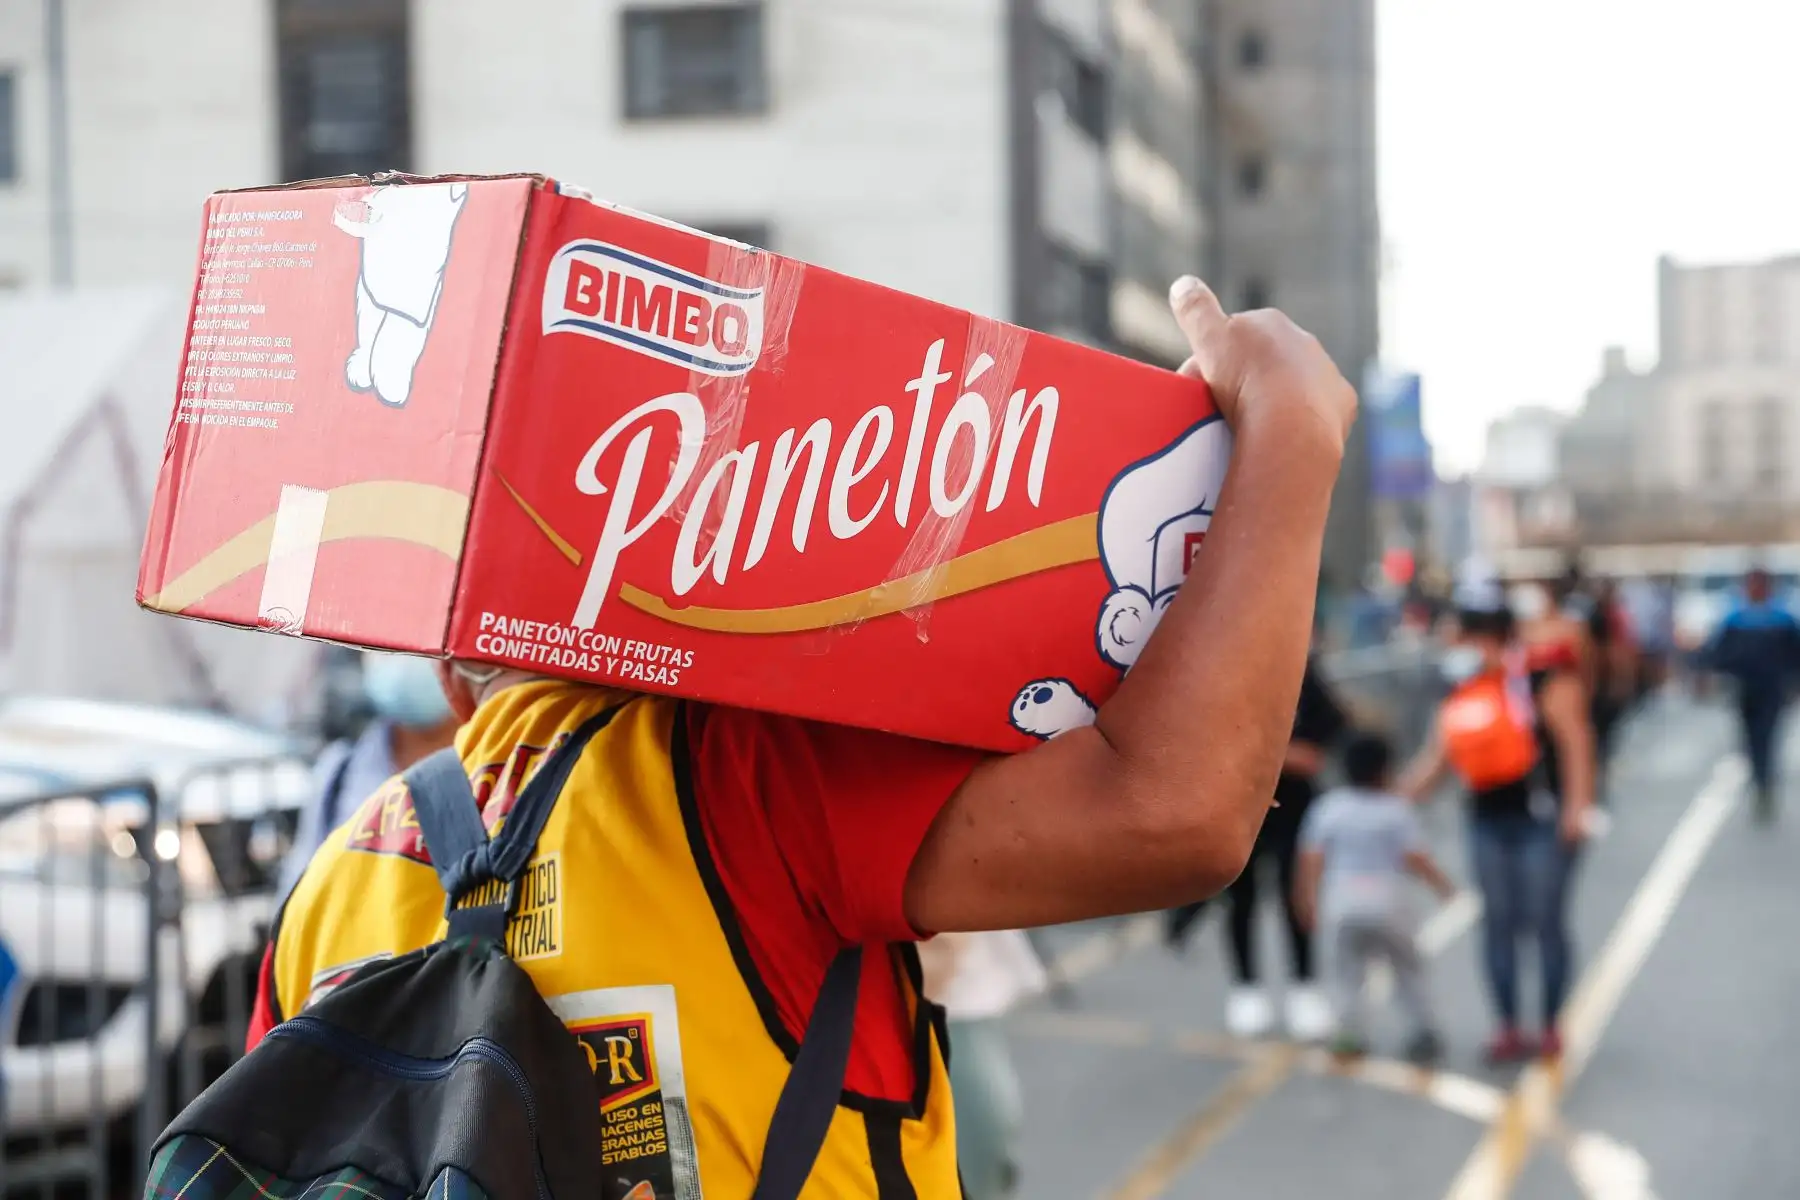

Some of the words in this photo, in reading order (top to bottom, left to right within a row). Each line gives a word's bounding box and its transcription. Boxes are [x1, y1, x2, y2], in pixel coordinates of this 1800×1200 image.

[563, 258, 749, 357] BIMBO
[220, 319, 250, 330] PERUANO
[226, 336, 247, 346] LUGAR
[208, 351, 231, 362] OLORES
[241, 367, 267, 378] DIRECTA
[274, 368, 283, 379] LA
[283, 369, 297, 380] LUZ
[263, 401, 284, 413] ANTES
[285, 402, 294, 414] DE
[229, 415, 238, 426] EN
[238, 416, 246, 427] EL
[575, 338, 1060, 629] Panetón
[479, 611, 578, 646] PANETÓN
[578, 631, 622, 655] CON
[622, 639, 695, 668] FRUTAS
[475, 634, 602, 673] CONFITADAS
[605, 656, 619, 675] Y
[619, 660, 681, 686] PASAS
[511, 909, 557, 958] TRIAL
[606, 1107, 638, 1124] USO
[641, 1101, 662, 1116] EN
[602, 1140, 667, 1165] STABLOS
